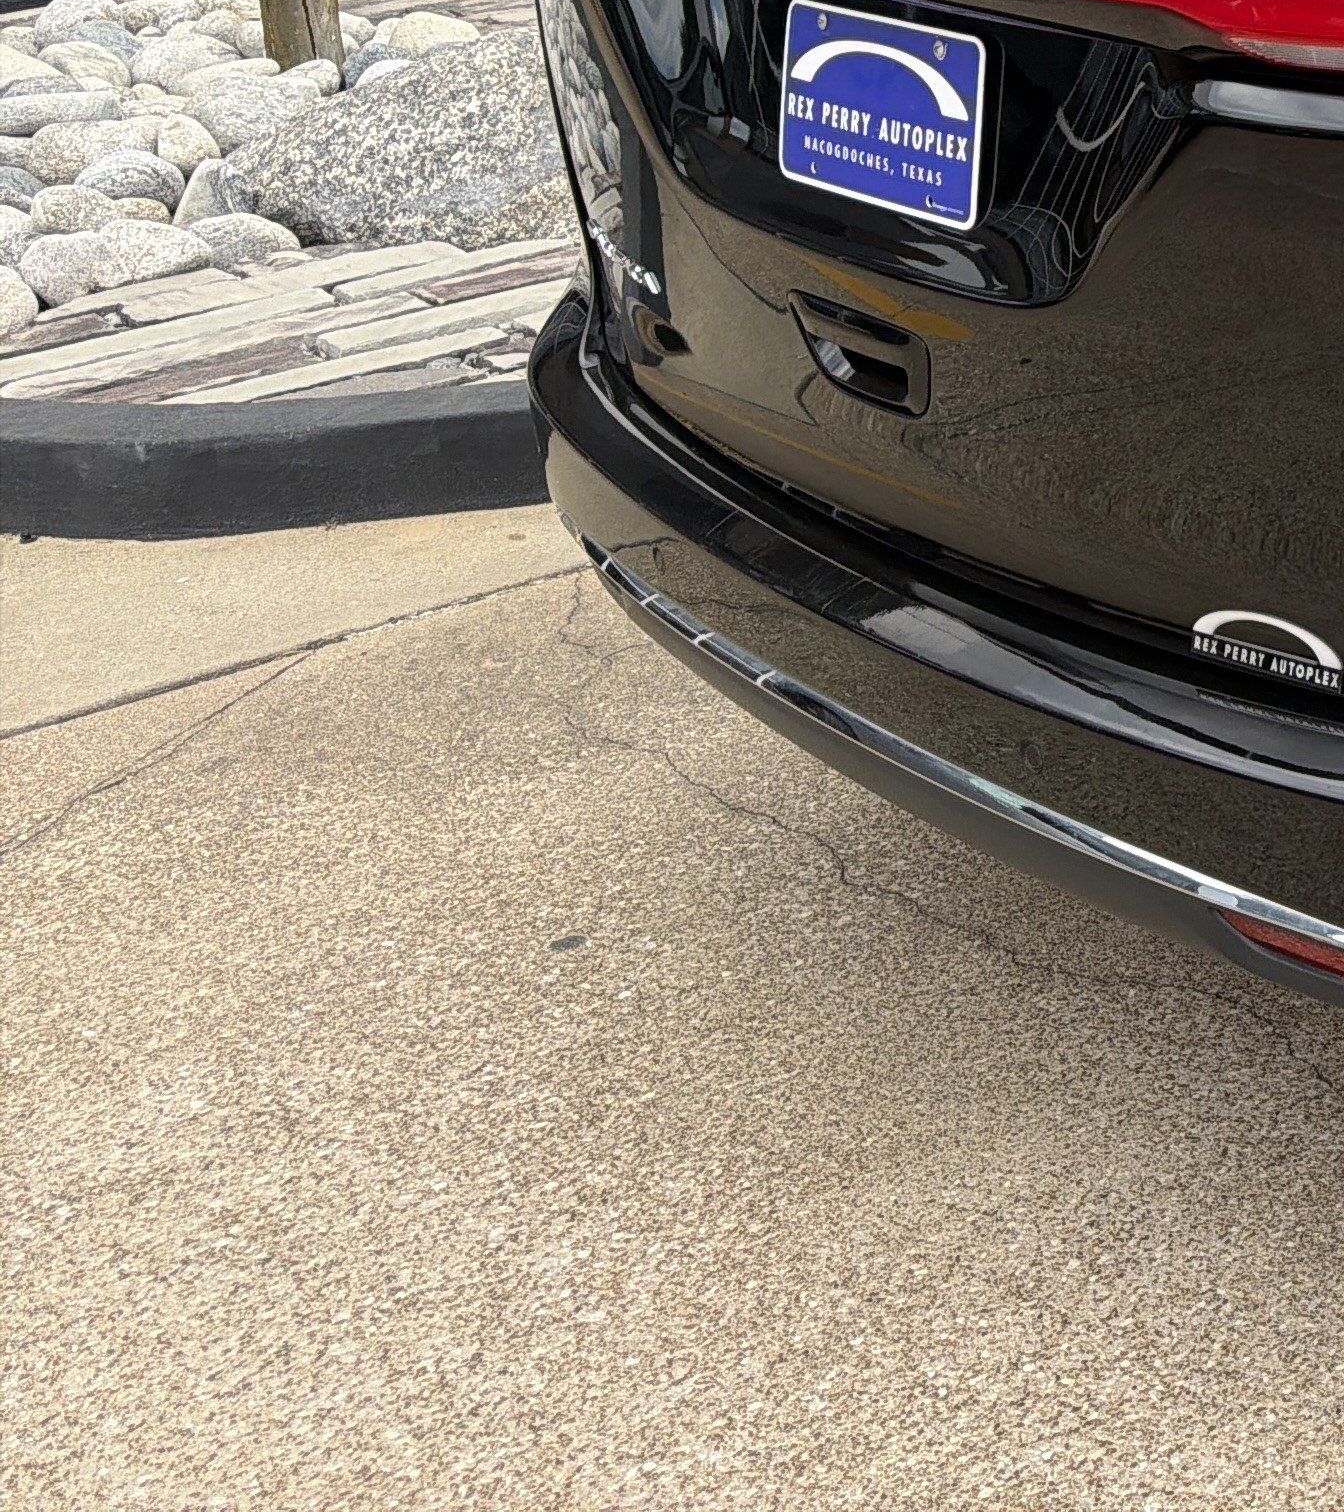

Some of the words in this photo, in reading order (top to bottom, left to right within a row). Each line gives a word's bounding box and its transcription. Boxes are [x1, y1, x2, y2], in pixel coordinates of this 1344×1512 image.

[787, 92, 815, 121] REX
[822, 102, 871, 136] PERRY
[878, 117, 968, 162] AUTOPLEX
[804, 135, 894, 176] NACOGDOCHES,
[902, 162, 942, 187] TEXAS
[1193, 635, 1218, 655] REX
[1224, 643, 1266, 668] PERRY
[1270, 657, 1341, 688] AUTOPLEX
